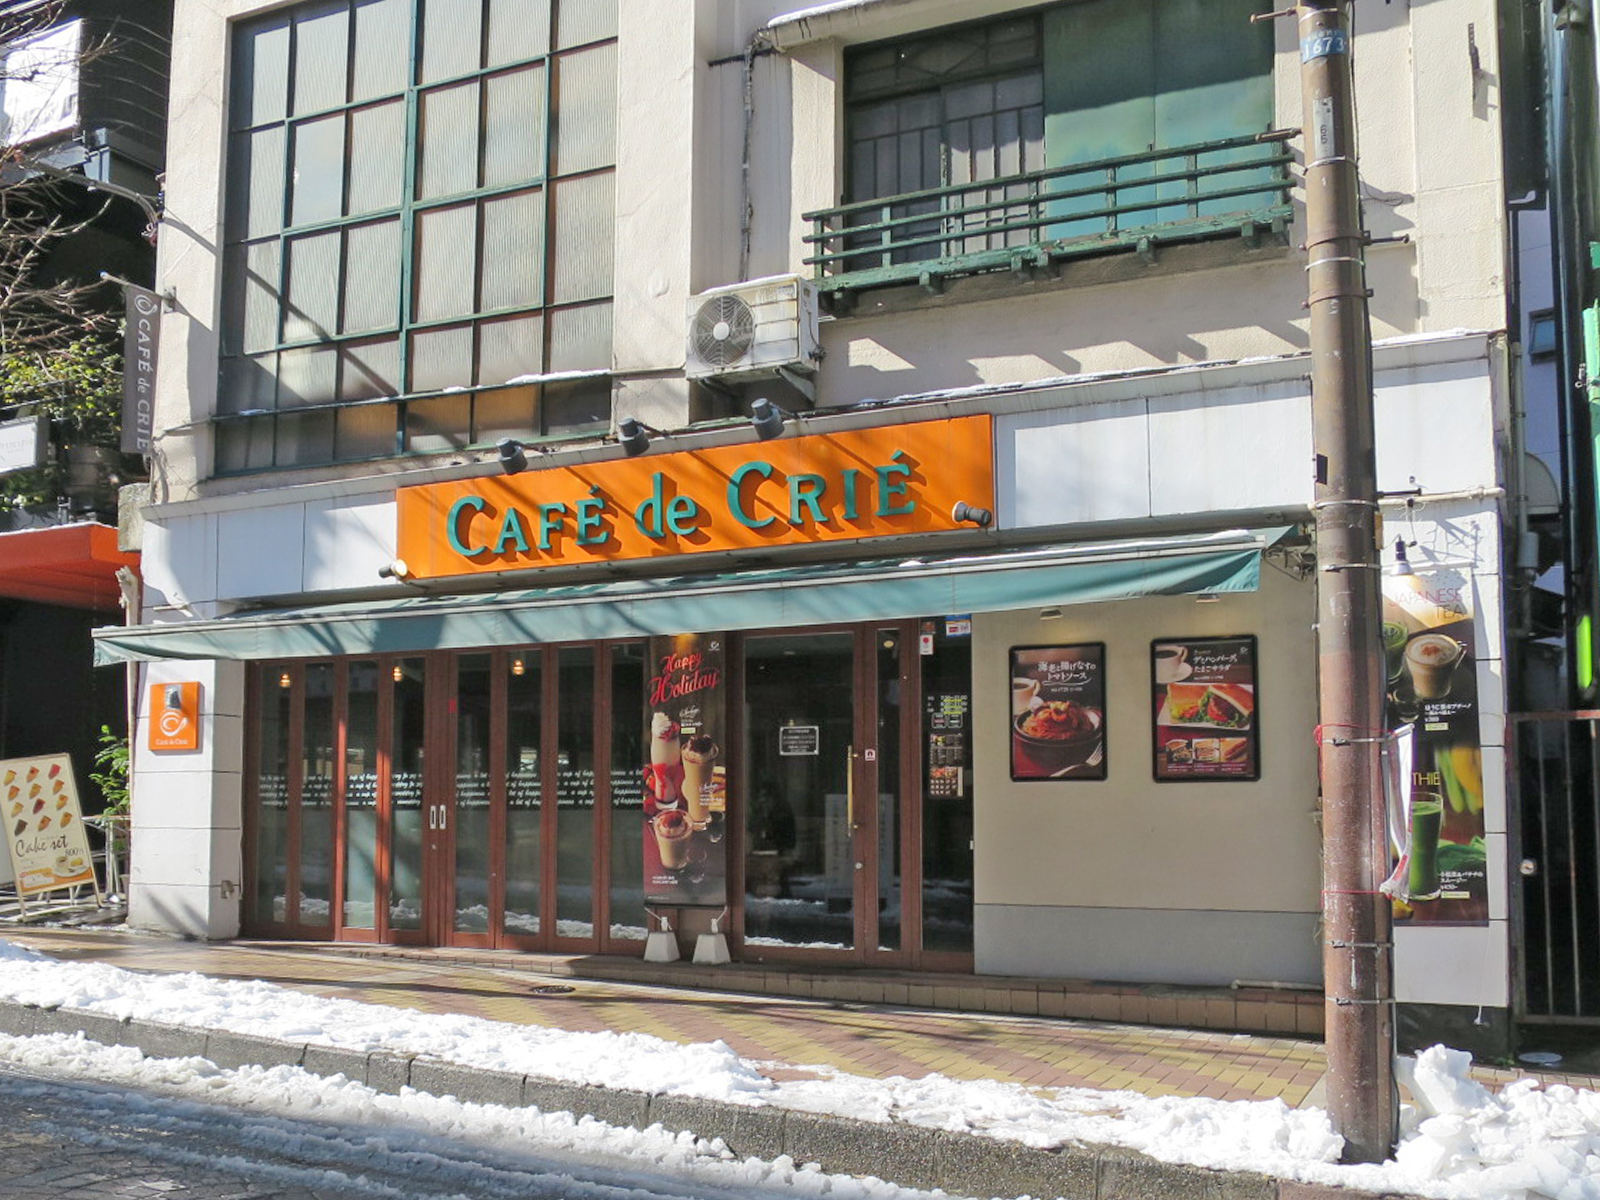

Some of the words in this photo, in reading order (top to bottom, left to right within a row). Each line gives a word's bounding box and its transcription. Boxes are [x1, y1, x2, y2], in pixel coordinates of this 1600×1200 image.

[1305, 37, 1344, 58] 1673
[137, 377, 151, 394] de
[446, 484, 610, 557] CAFÉ
[634, 472, 700, 539] de
[726, 449, 916, 529] CRIÉ
[1389, 587, 1462, 607] JAPANESE
[1435, 604, 1468, 619] TEA
[660, 653, 703, 674] Happy
[648, 667, 719, 706] Holiday
[15, 837, 48, 858] Cake
[50, 835, 69, 849] set
